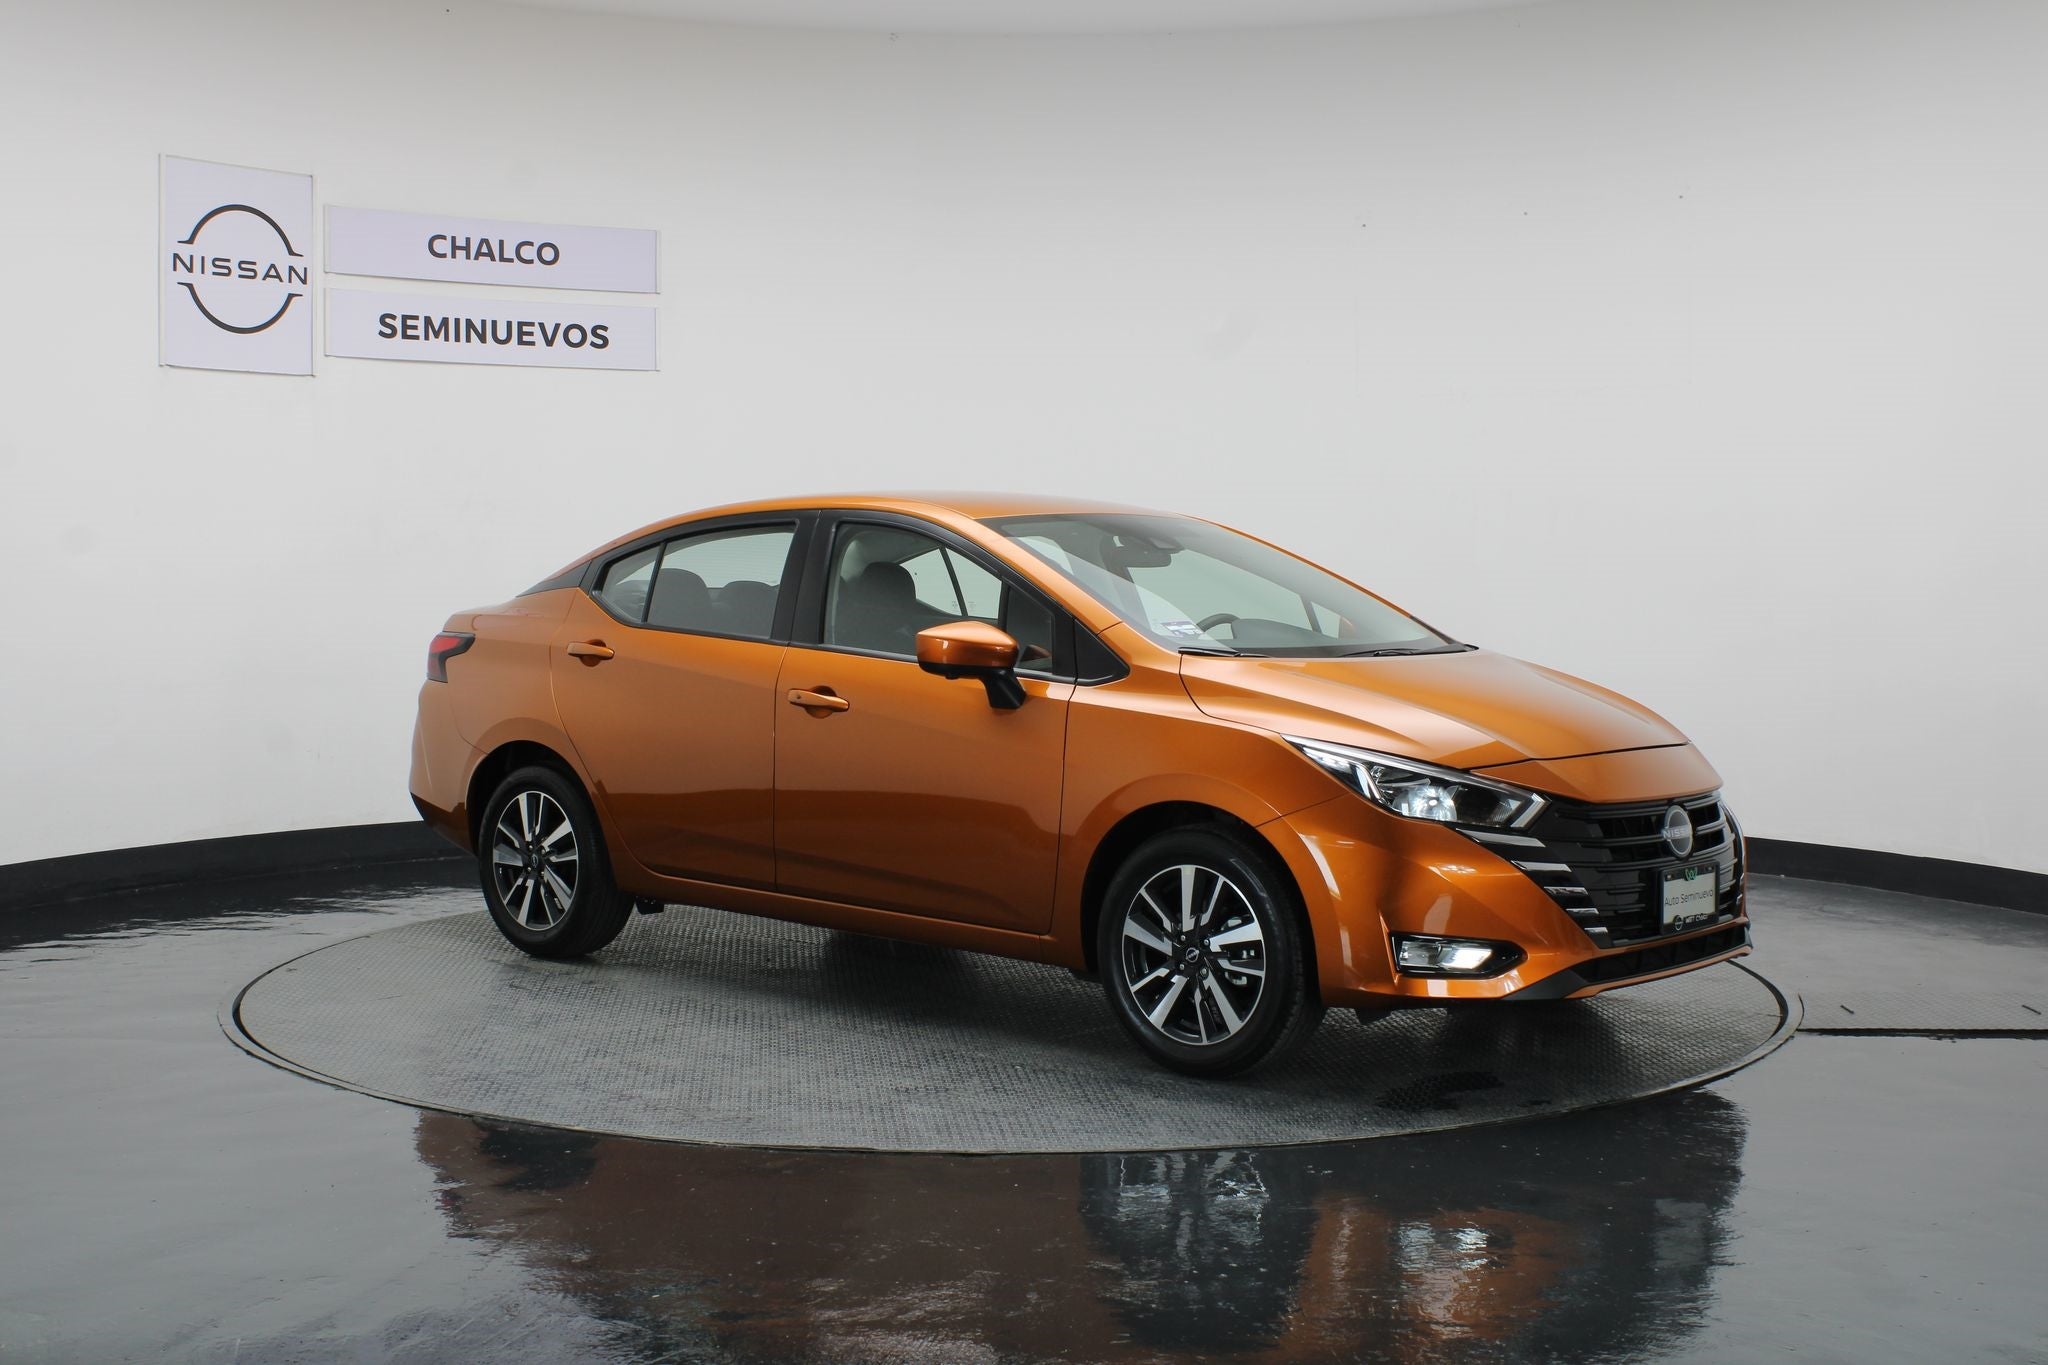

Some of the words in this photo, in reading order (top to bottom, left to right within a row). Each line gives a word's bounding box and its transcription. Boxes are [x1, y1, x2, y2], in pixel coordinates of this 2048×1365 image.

[428, 234, 560, 267] CHALCO
[172, 252, 308, 286] NISSAN
[378, 313, 611, 350] SEMINUEVOS
[1664, 896, 1680, 906] Auto
[1681, 889, 1714, 904] Seminuevo
